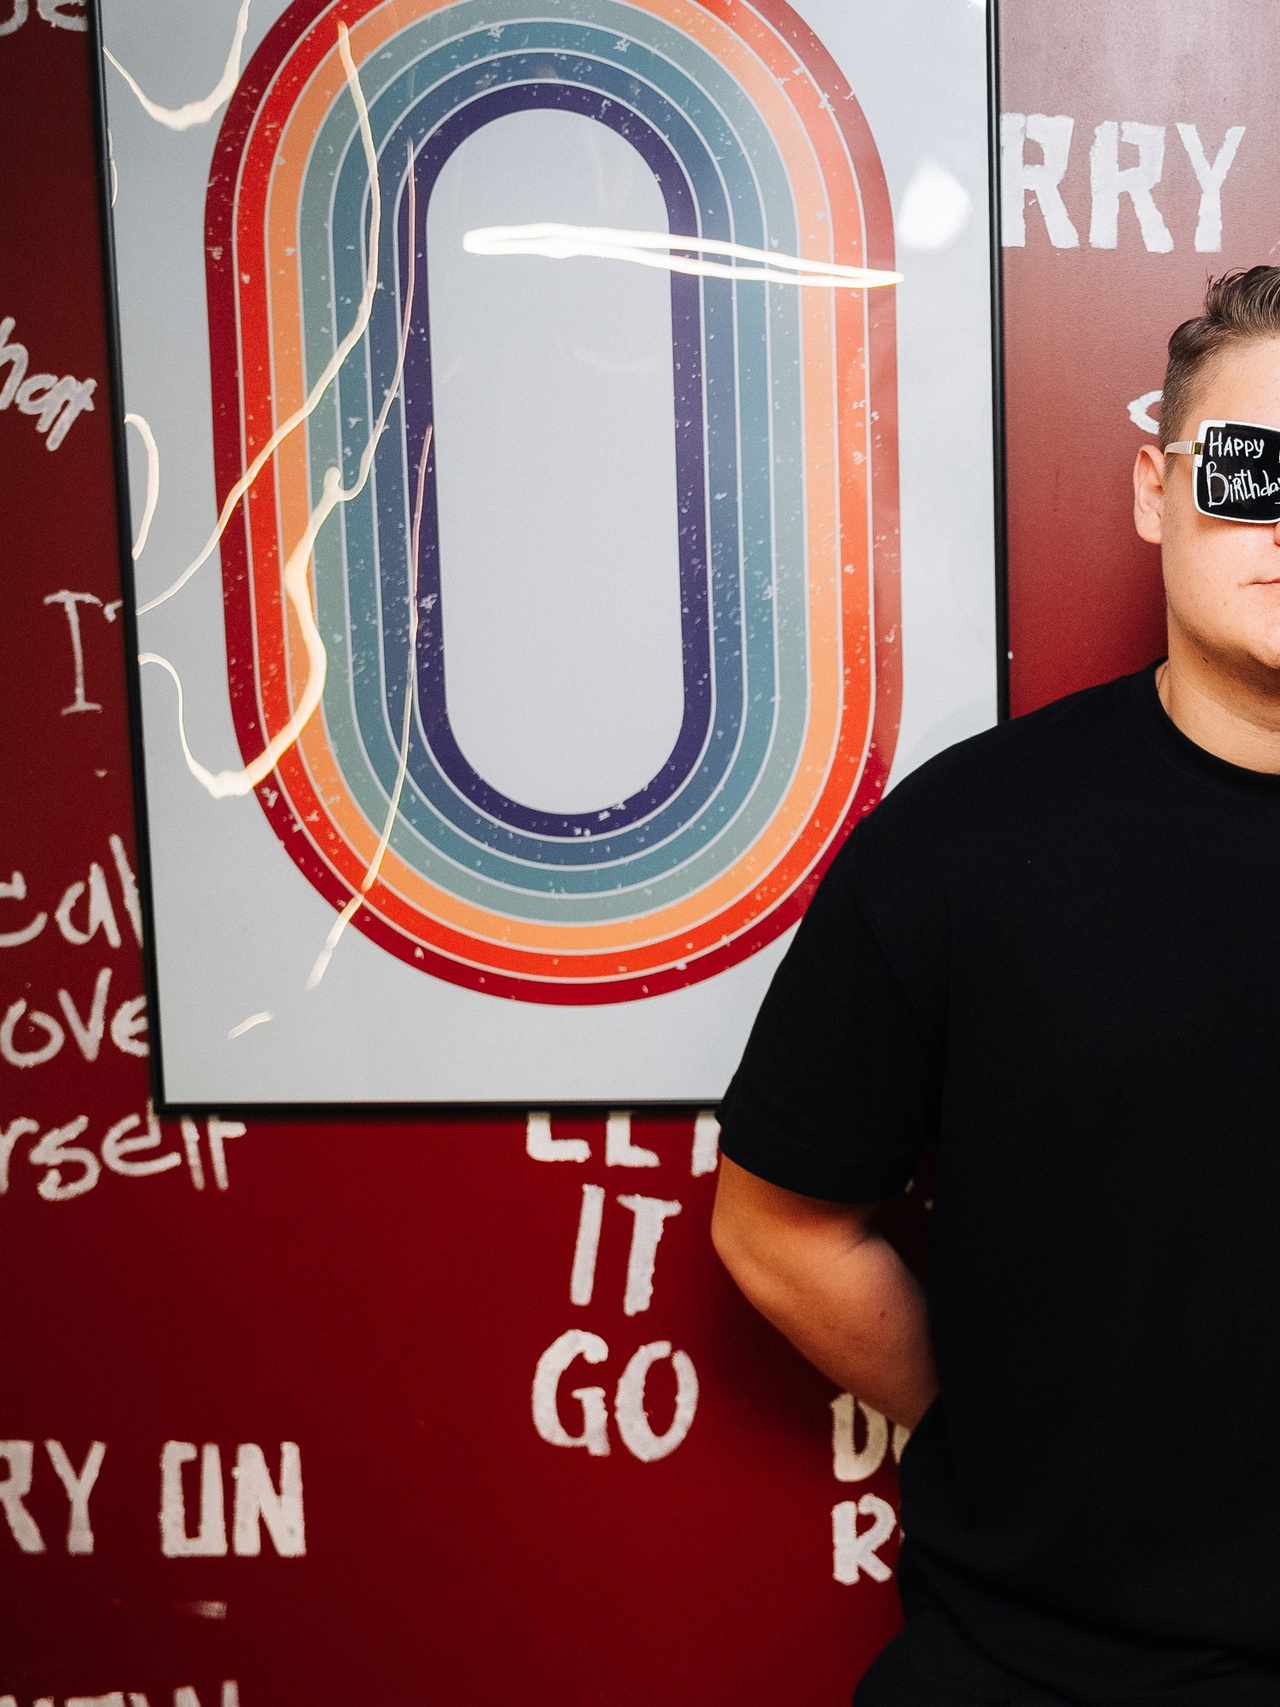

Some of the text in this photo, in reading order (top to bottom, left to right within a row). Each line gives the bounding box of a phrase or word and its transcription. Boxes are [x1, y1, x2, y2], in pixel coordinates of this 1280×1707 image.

[1209, 430, 1265, 459] HAPPY
[570, 1183, 682, 1317] IT
[532, 1328, 700, 1463] GO
[159, 1440, 306, 1558] ON
